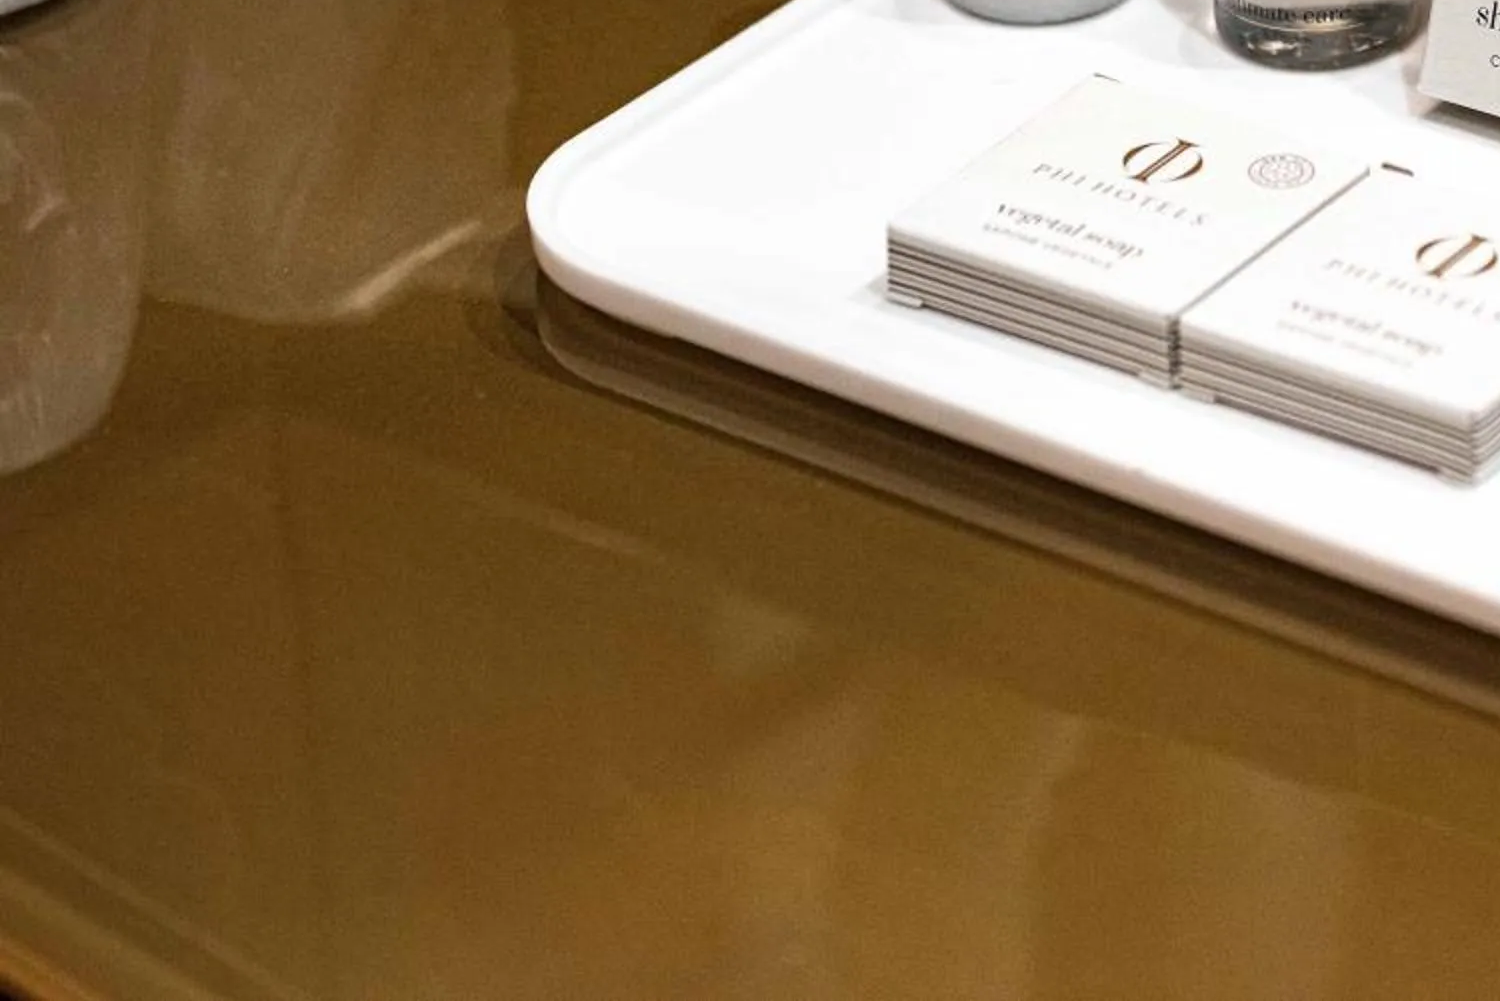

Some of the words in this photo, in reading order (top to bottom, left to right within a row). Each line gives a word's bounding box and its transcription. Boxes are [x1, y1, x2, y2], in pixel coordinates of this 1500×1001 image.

[996, 202, 1088, 238] vegetal
[1031, 162, 1088, 187] PHI
[1089, 180, 1210, 228] HOTELS
